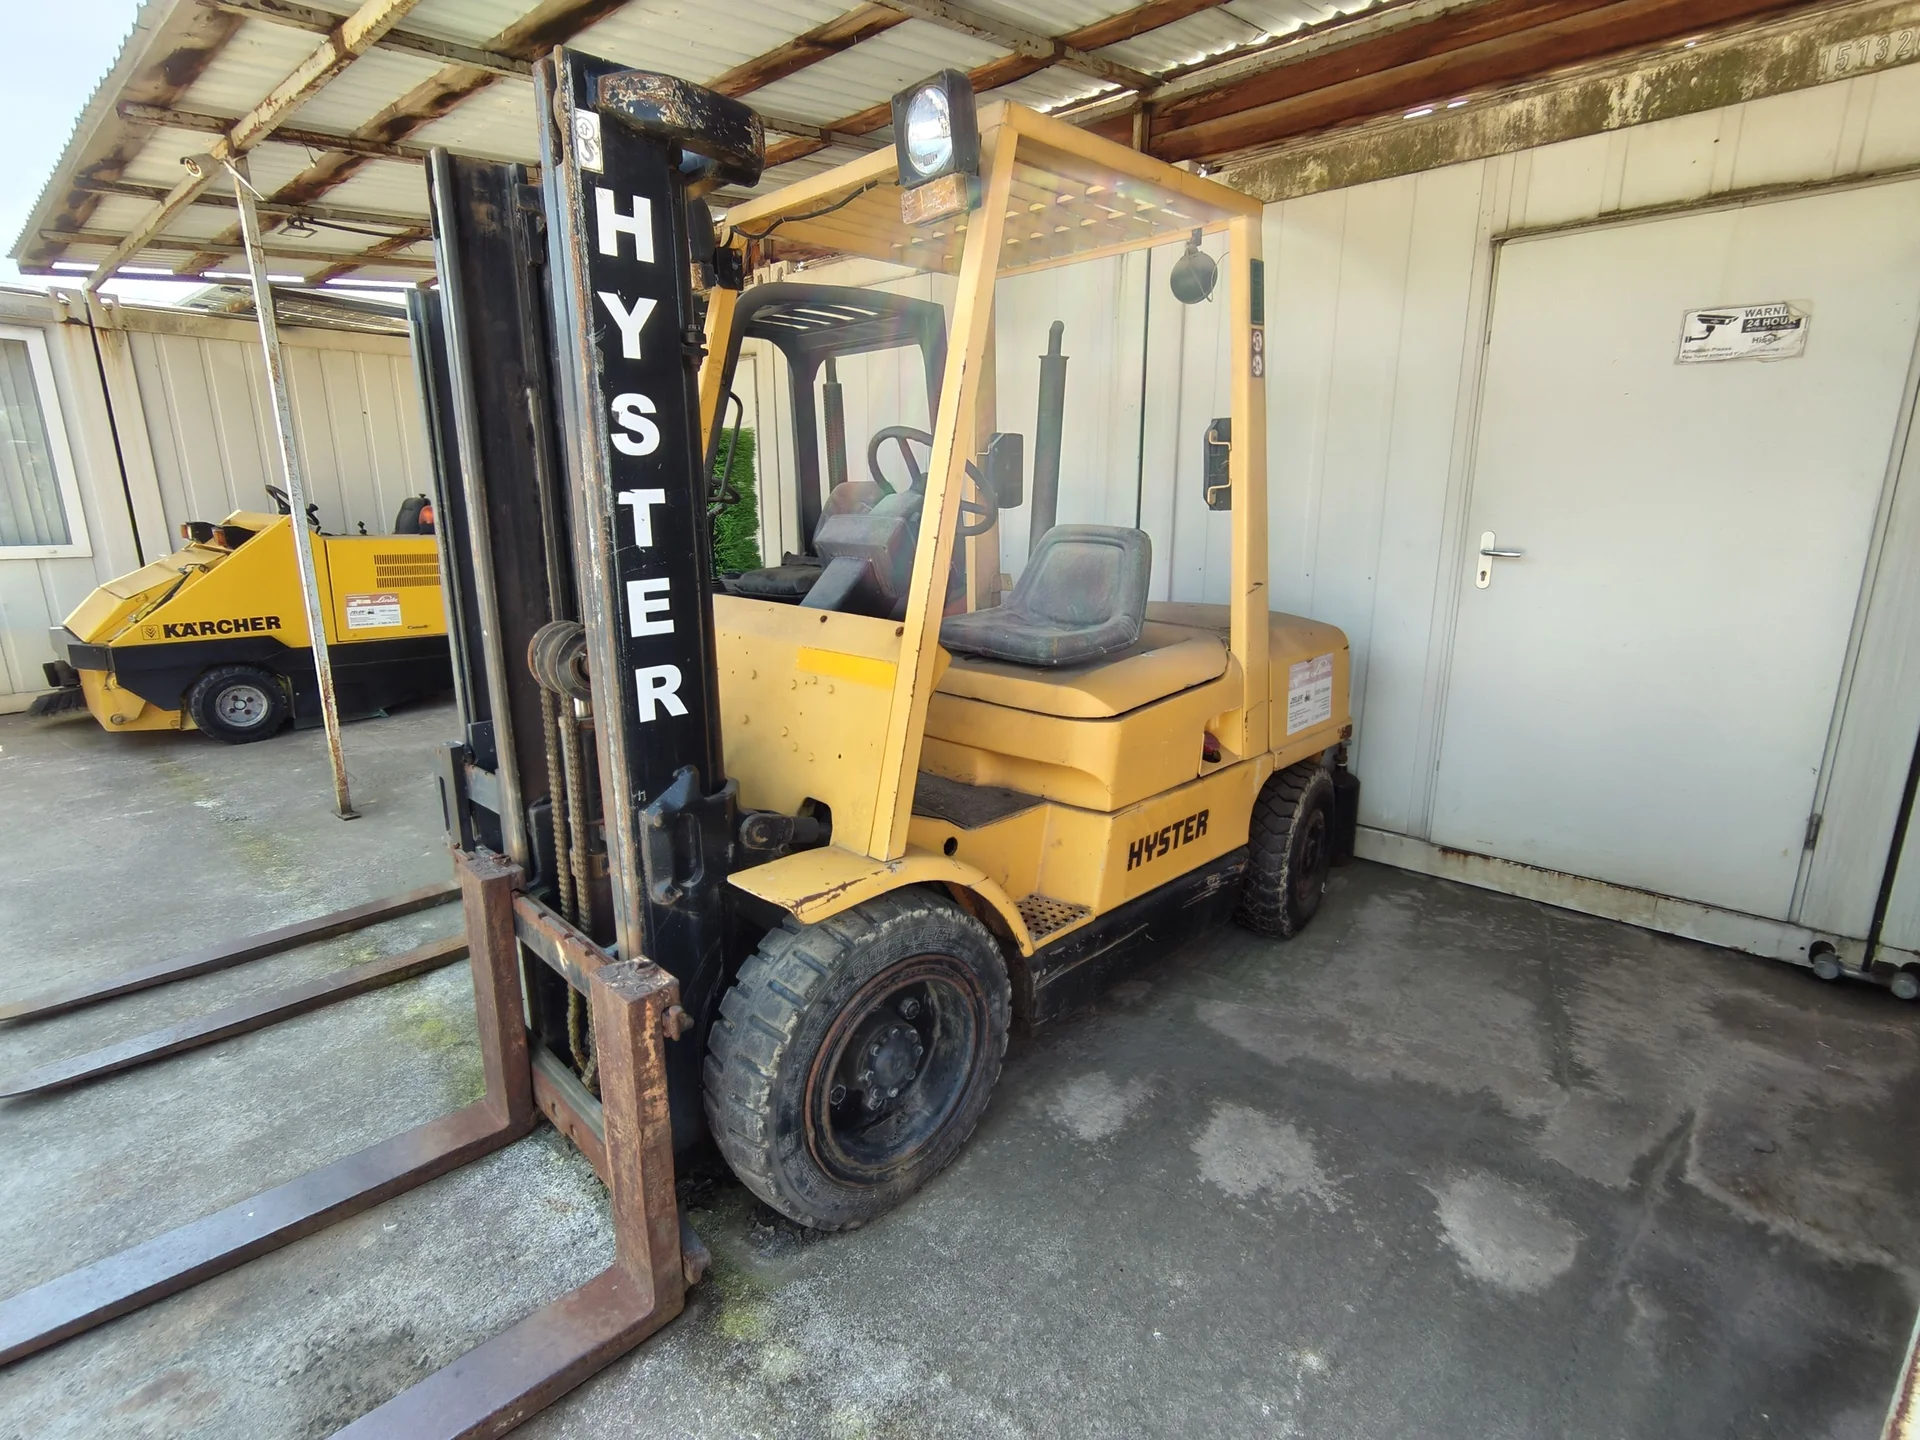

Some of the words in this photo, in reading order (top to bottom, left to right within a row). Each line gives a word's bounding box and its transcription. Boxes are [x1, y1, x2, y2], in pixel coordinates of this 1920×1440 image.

[1819, 30, 1920, 75] 15132
[1744, 306, 1789, 317] WARNI
[1746, 319, 1761, 328] 24
[594, 187, 690, 723] HYSTER
[163, 615, 282, 639] KÄRCHER
[1126, 808, 1210, 872] HYSTER
